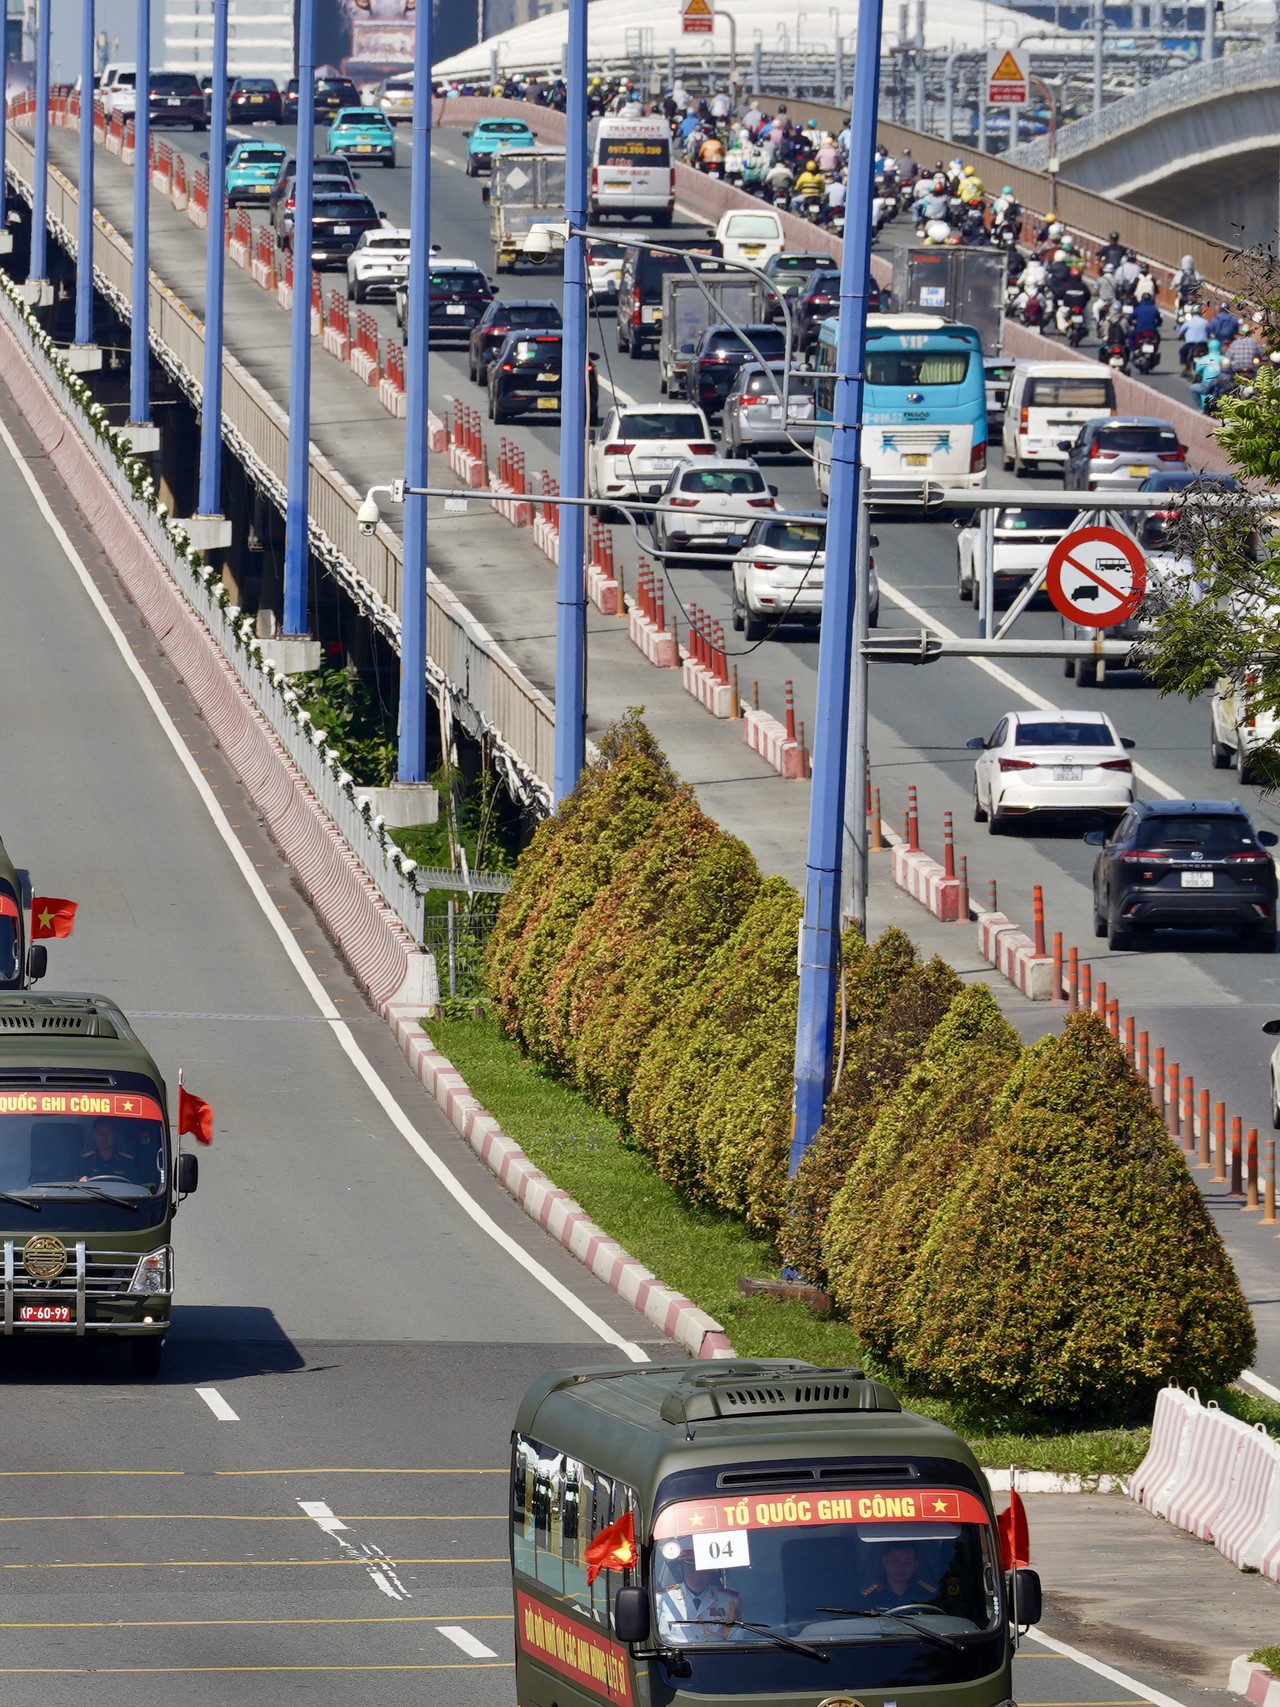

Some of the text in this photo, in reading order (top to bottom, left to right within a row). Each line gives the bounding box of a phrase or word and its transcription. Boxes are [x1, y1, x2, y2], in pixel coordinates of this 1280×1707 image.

[900, 335, 929, 349] VIP
[41, 1097, 66, 1112] GHI
[70, 1095, 110, 1113] CÔNG
[724, 1494, 915, 1526] TỔ QUỐC GHI CÔNG
[709, 1540, 734, 1560] 04
